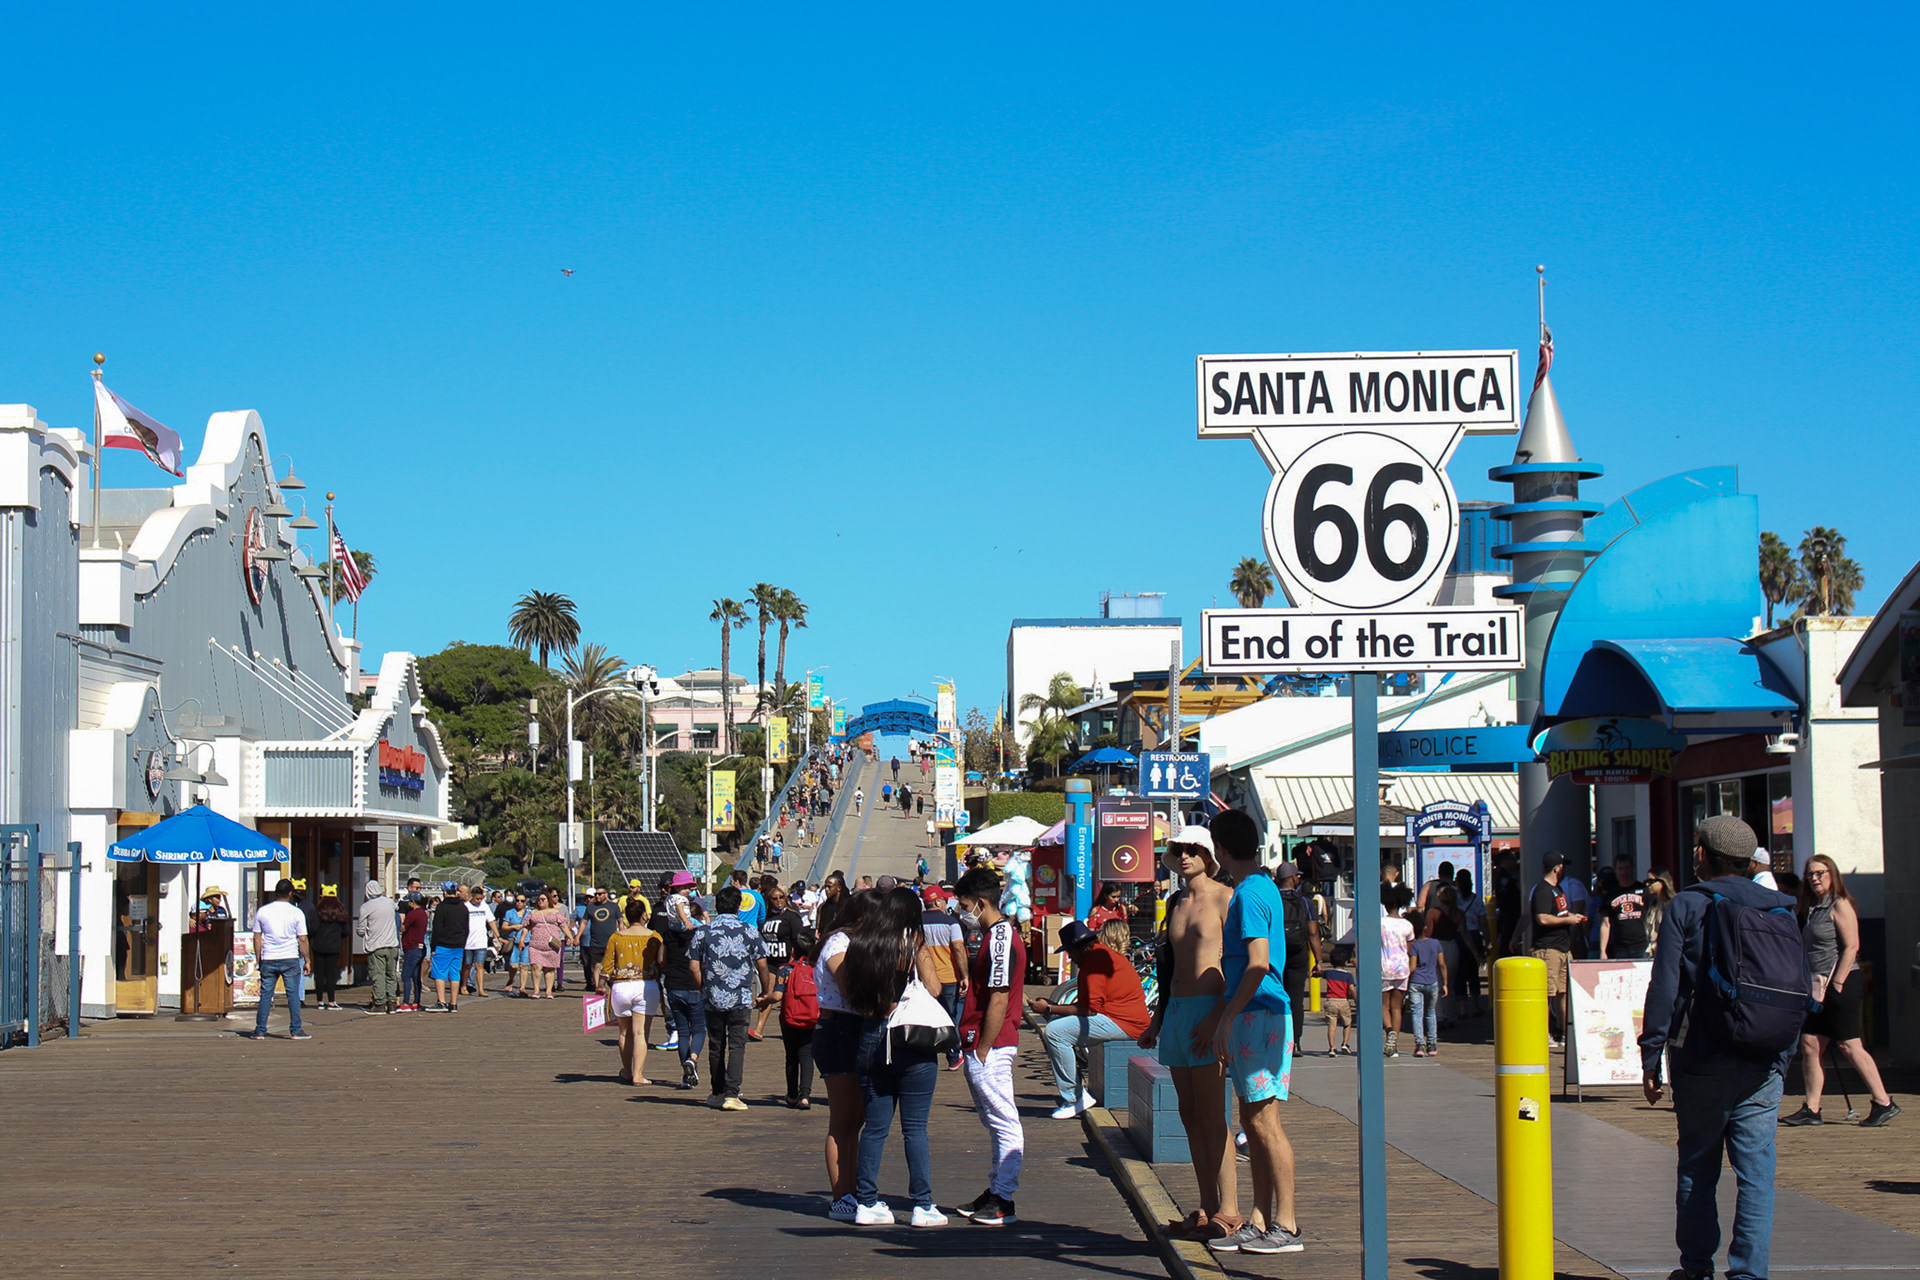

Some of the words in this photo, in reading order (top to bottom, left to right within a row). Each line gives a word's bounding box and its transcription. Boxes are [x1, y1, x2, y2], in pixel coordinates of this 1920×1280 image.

[1211, 370, 1334, 415] SANTA
[1350, 367, 1505, 414] MONICA
[1293, 461, 1429, 582] 66
[1221, 620, 1290, 660] End
[1305, 619, 1342, 659] of
[1356, 618, 1414, 658] the
[1427, 616, 1508, 656] Trail
[1409, 735, 1478, 757] POLICE
[1150, 753, 1199, 762] RESTROOMS
[1548, 749, 1610, 778] BLAZING
[1613, 747, 1674, 775] SADDLES
[1605, 768, 1639, 776] RENTALS
[1418, 812, 1443, 827] SANTA
[1445, 812, 1478, 826] MONICA
[155, 850, 188, 860] SHRIMP
[190, 851, 204, 860] CO.
[219, 848, 243, 858] BUBBA
[244, 849, 268, 859] GUMP
[1076, 827, 1087, 890] Emergency
